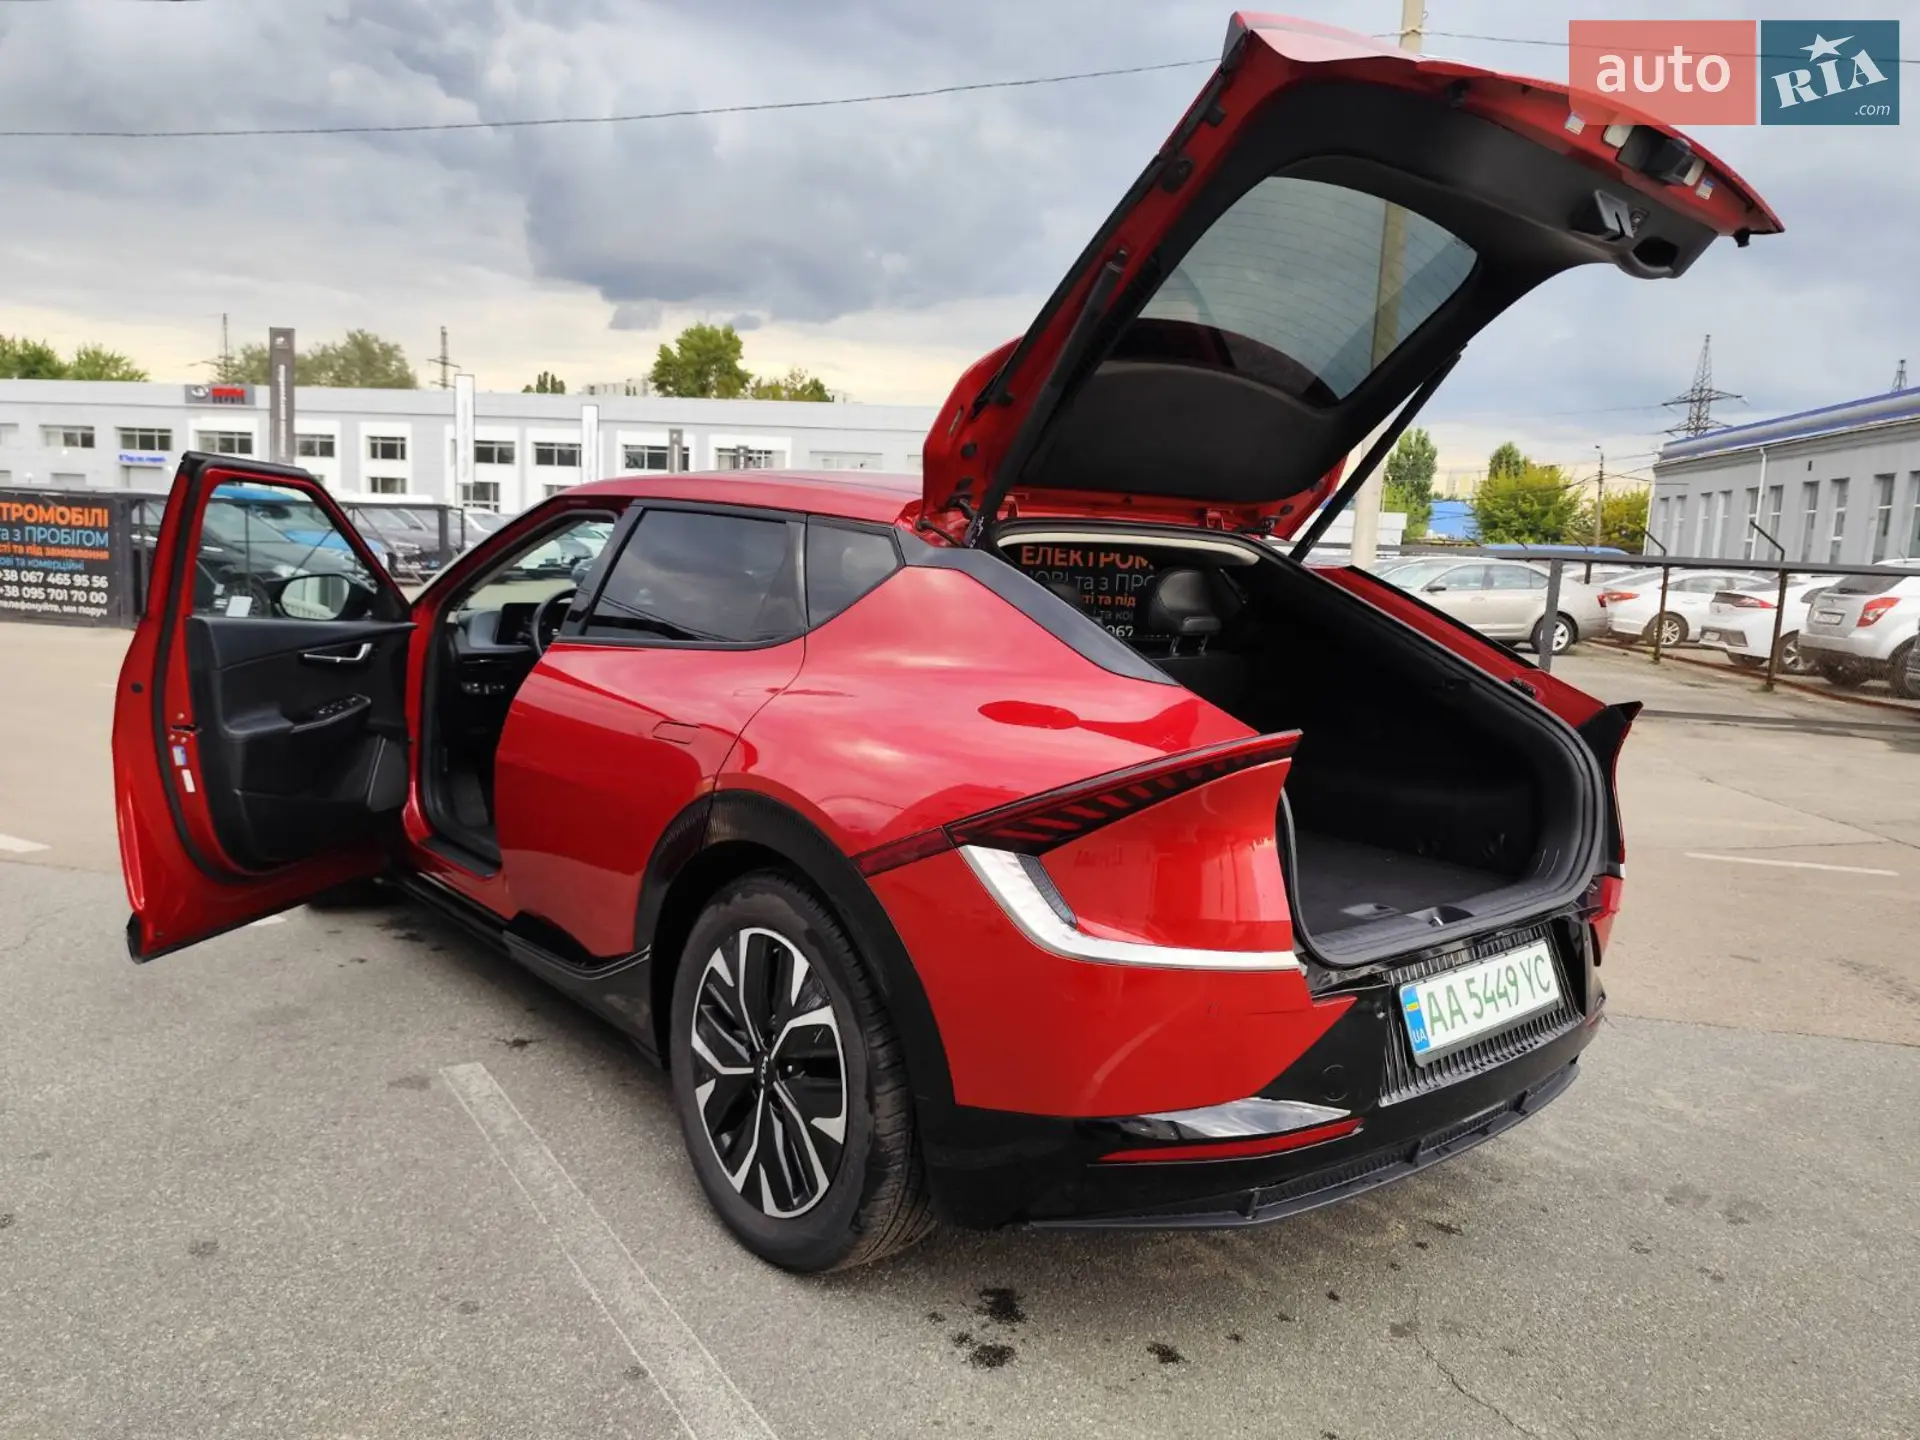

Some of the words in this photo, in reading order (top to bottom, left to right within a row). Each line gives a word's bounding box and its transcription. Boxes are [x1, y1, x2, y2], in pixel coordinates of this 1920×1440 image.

[24, 526, 109, 548] ПРОБІГОМ
[20, 570, 44, 584] 067
[46, 572, 71, 586] 465
[72, 574, 90, 588] 95
[91, 575, 109, 589] 56
[22, 586, 46, 600] 095
[47, 588, 68, 602] 701
[70, 590, 87, 603] 70
[89, 591, 108, 604] 00
[1115, 592, 1137, 608] під
[1425, 984, 1469, 1037] AA
[1465, 964, 1520, 1020] 5449
[1519, 953, 1551, 1000] YC
[1412, 1028, 1427, 1043] UA
